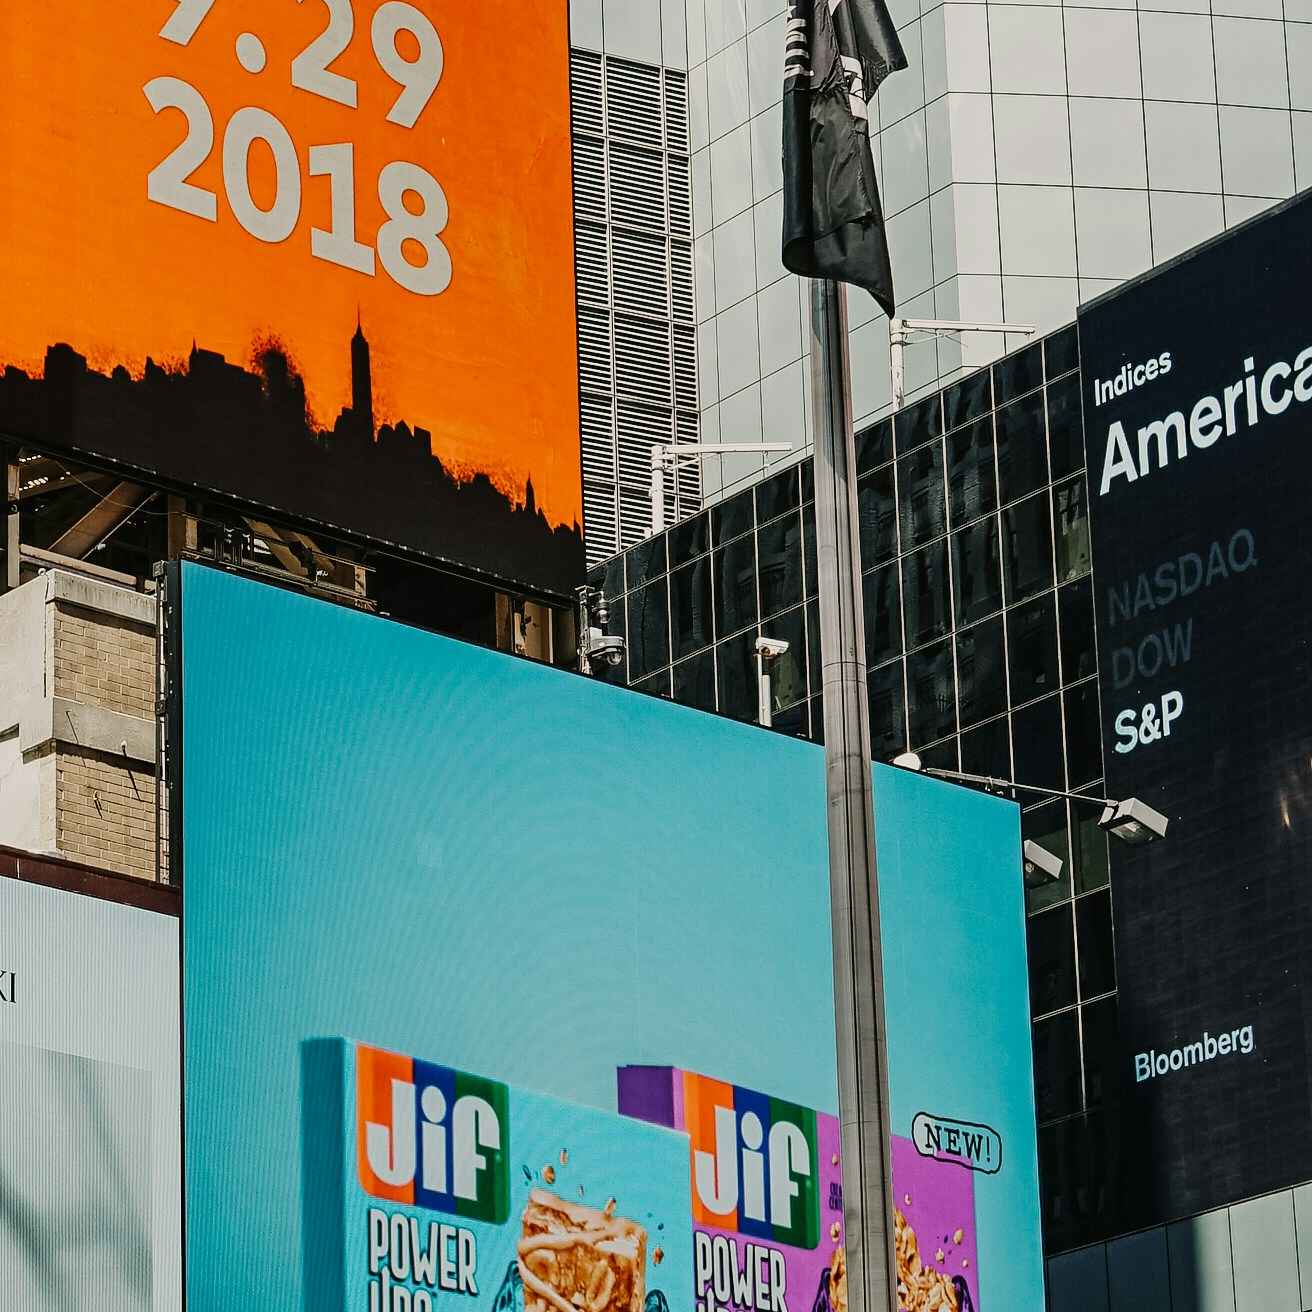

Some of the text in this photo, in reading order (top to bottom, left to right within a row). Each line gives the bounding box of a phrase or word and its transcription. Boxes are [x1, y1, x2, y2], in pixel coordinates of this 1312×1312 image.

[142, 76, 453, 296] 2018
[1094, 351, 1172, 407] Indices
[1108, 528, 1259, 626] NASDAQ
[1112, 619, 1194, 688] DOW
[1114, 690, 1184, 755] S&P
[1134, 1025, 1254, 1083] Bloomberg
[367, 1077, 501, 1202] Jif
[695, 1104, 811, 1230] Jif
[924, 1122, 991, 1163] NEW!
[368, 1208, 479, 1296] POWER
